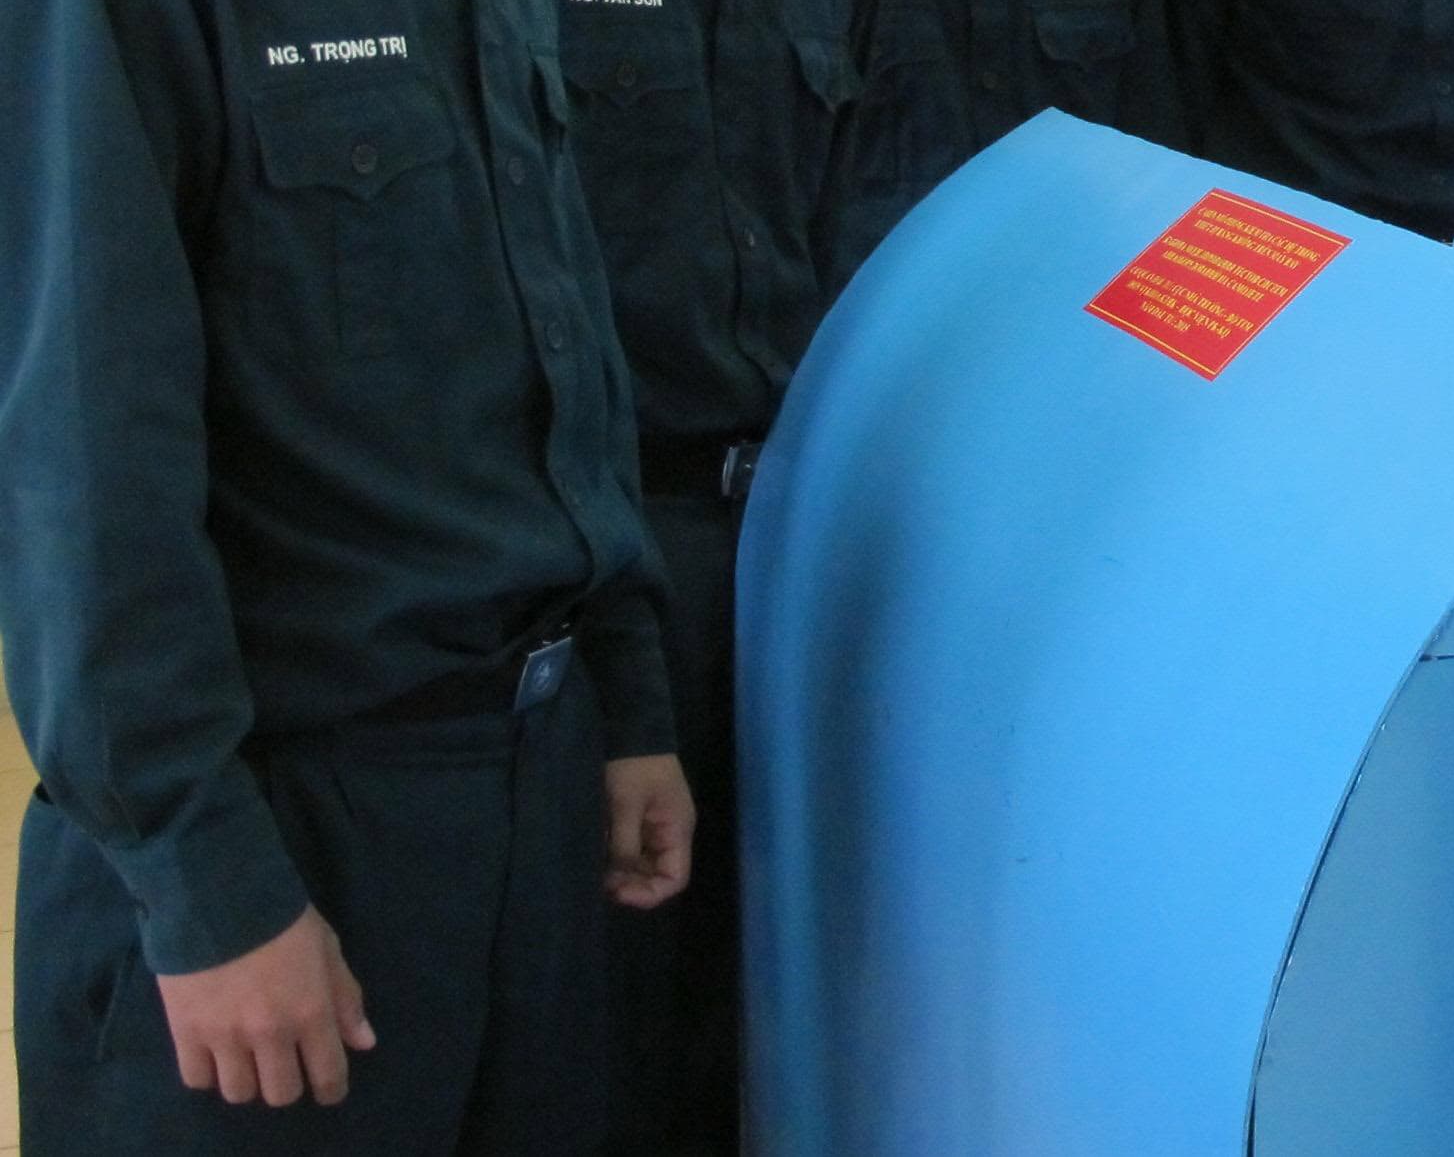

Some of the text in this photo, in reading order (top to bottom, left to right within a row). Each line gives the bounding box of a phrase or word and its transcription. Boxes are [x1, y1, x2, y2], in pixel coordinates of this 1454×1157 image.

[267, 35, 408, 65] NG. TRỌNG TRỊ
